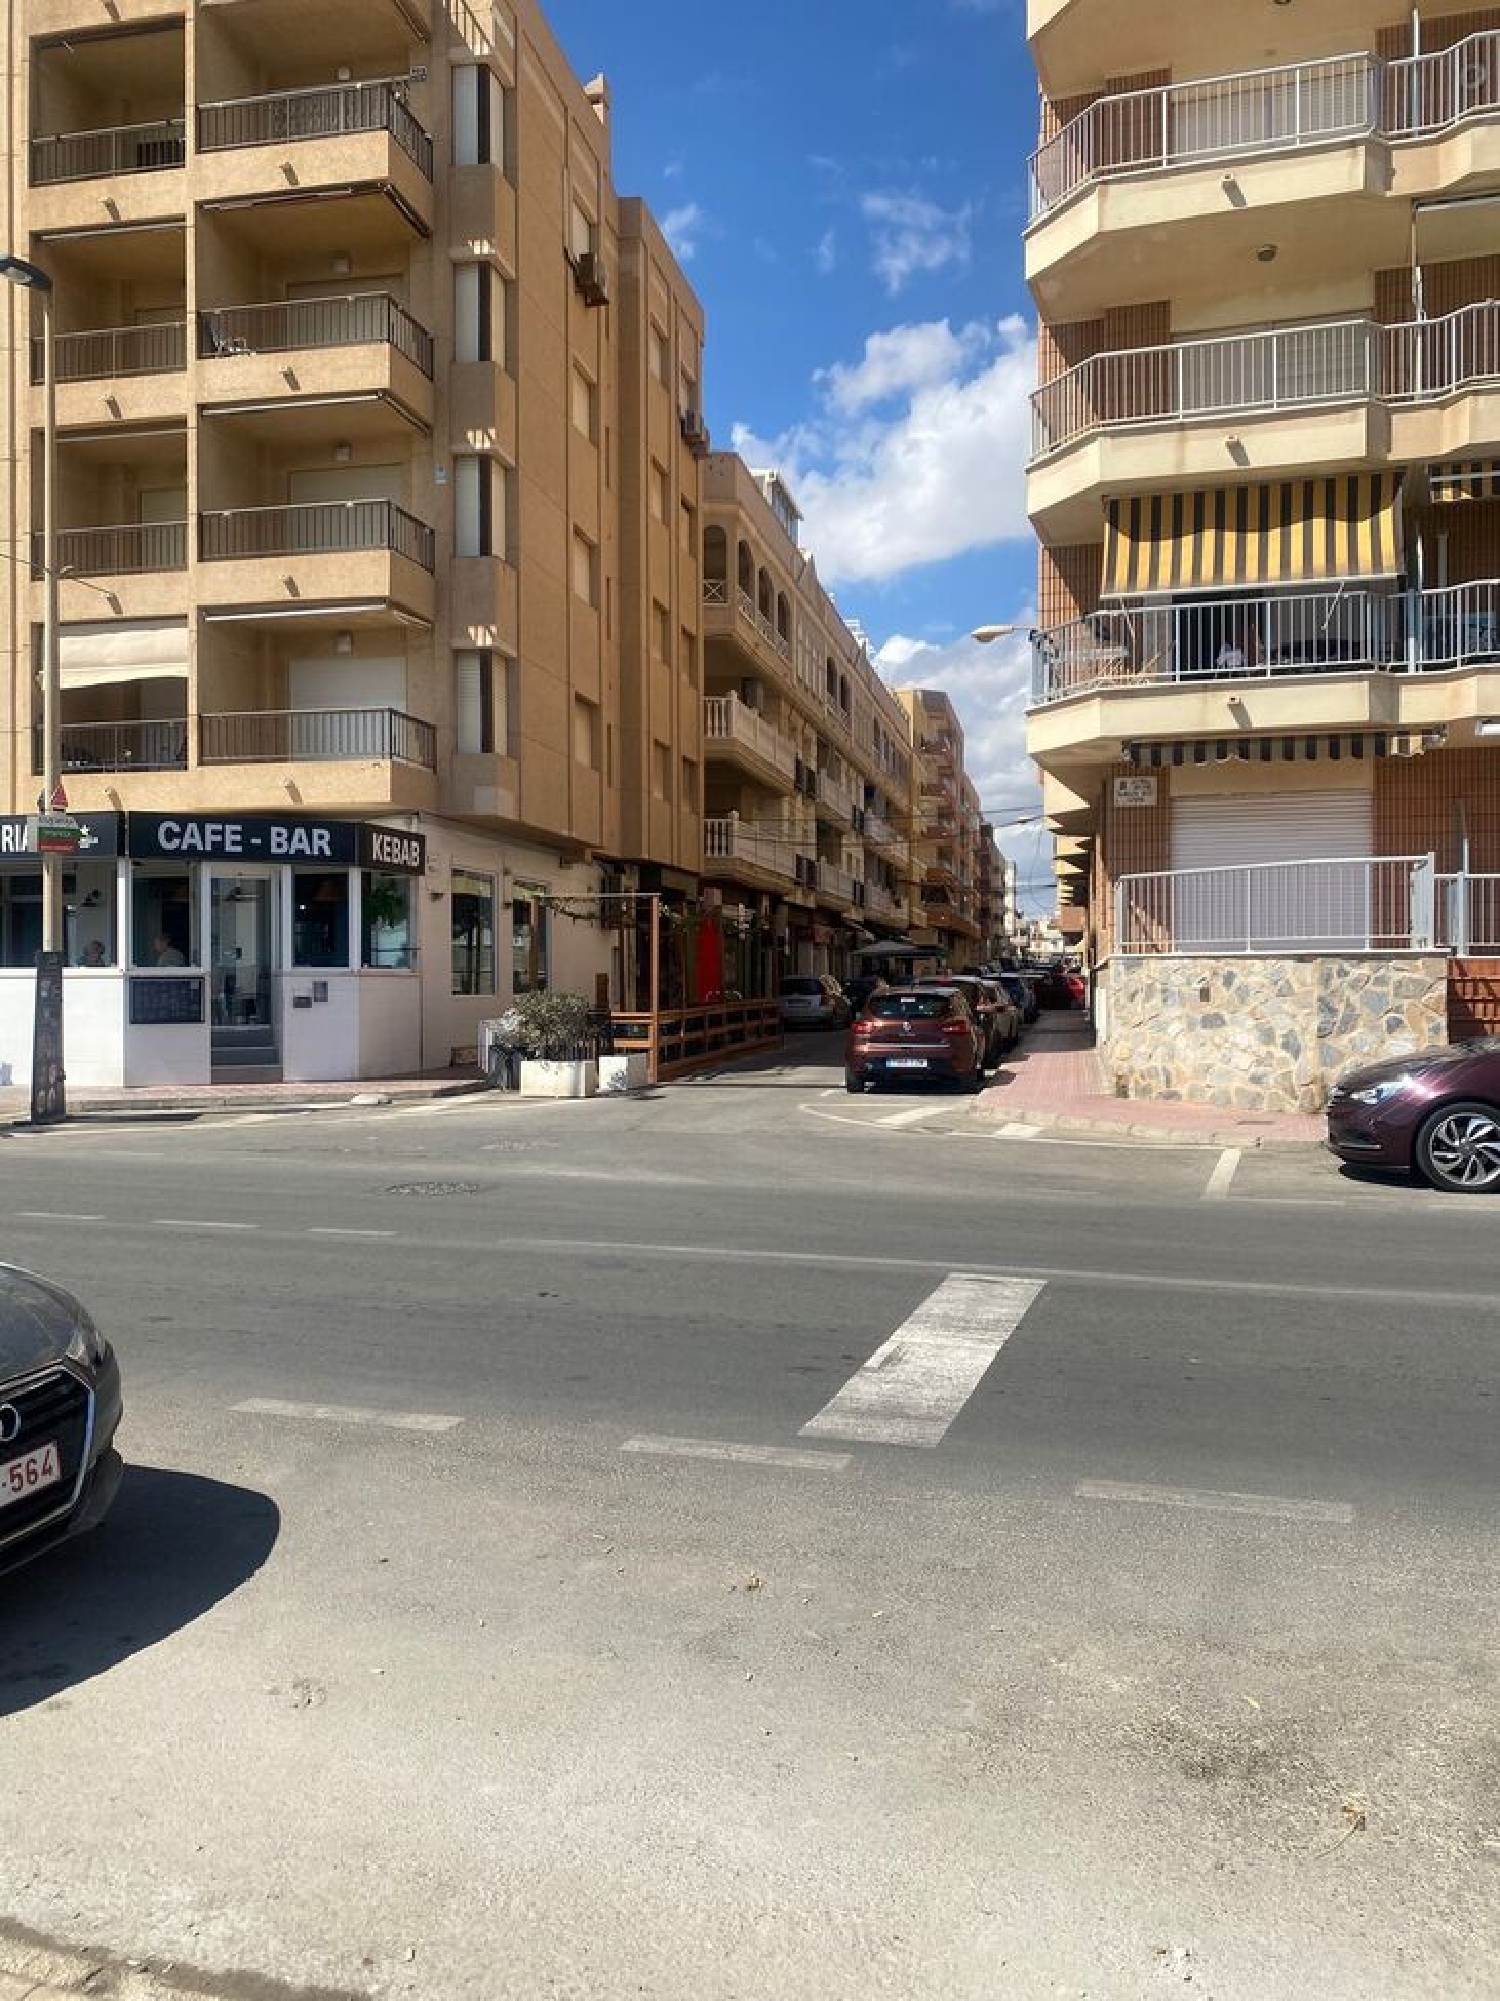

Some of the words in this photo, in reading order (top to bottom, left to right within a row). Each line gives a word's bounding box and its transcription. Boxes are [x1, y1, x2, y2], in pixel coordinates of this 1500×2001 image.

[157, 820, 243, 852] CAFE
[270, 826, 332, 856] BAR
[372, 832, 420, 867] KEBAB
